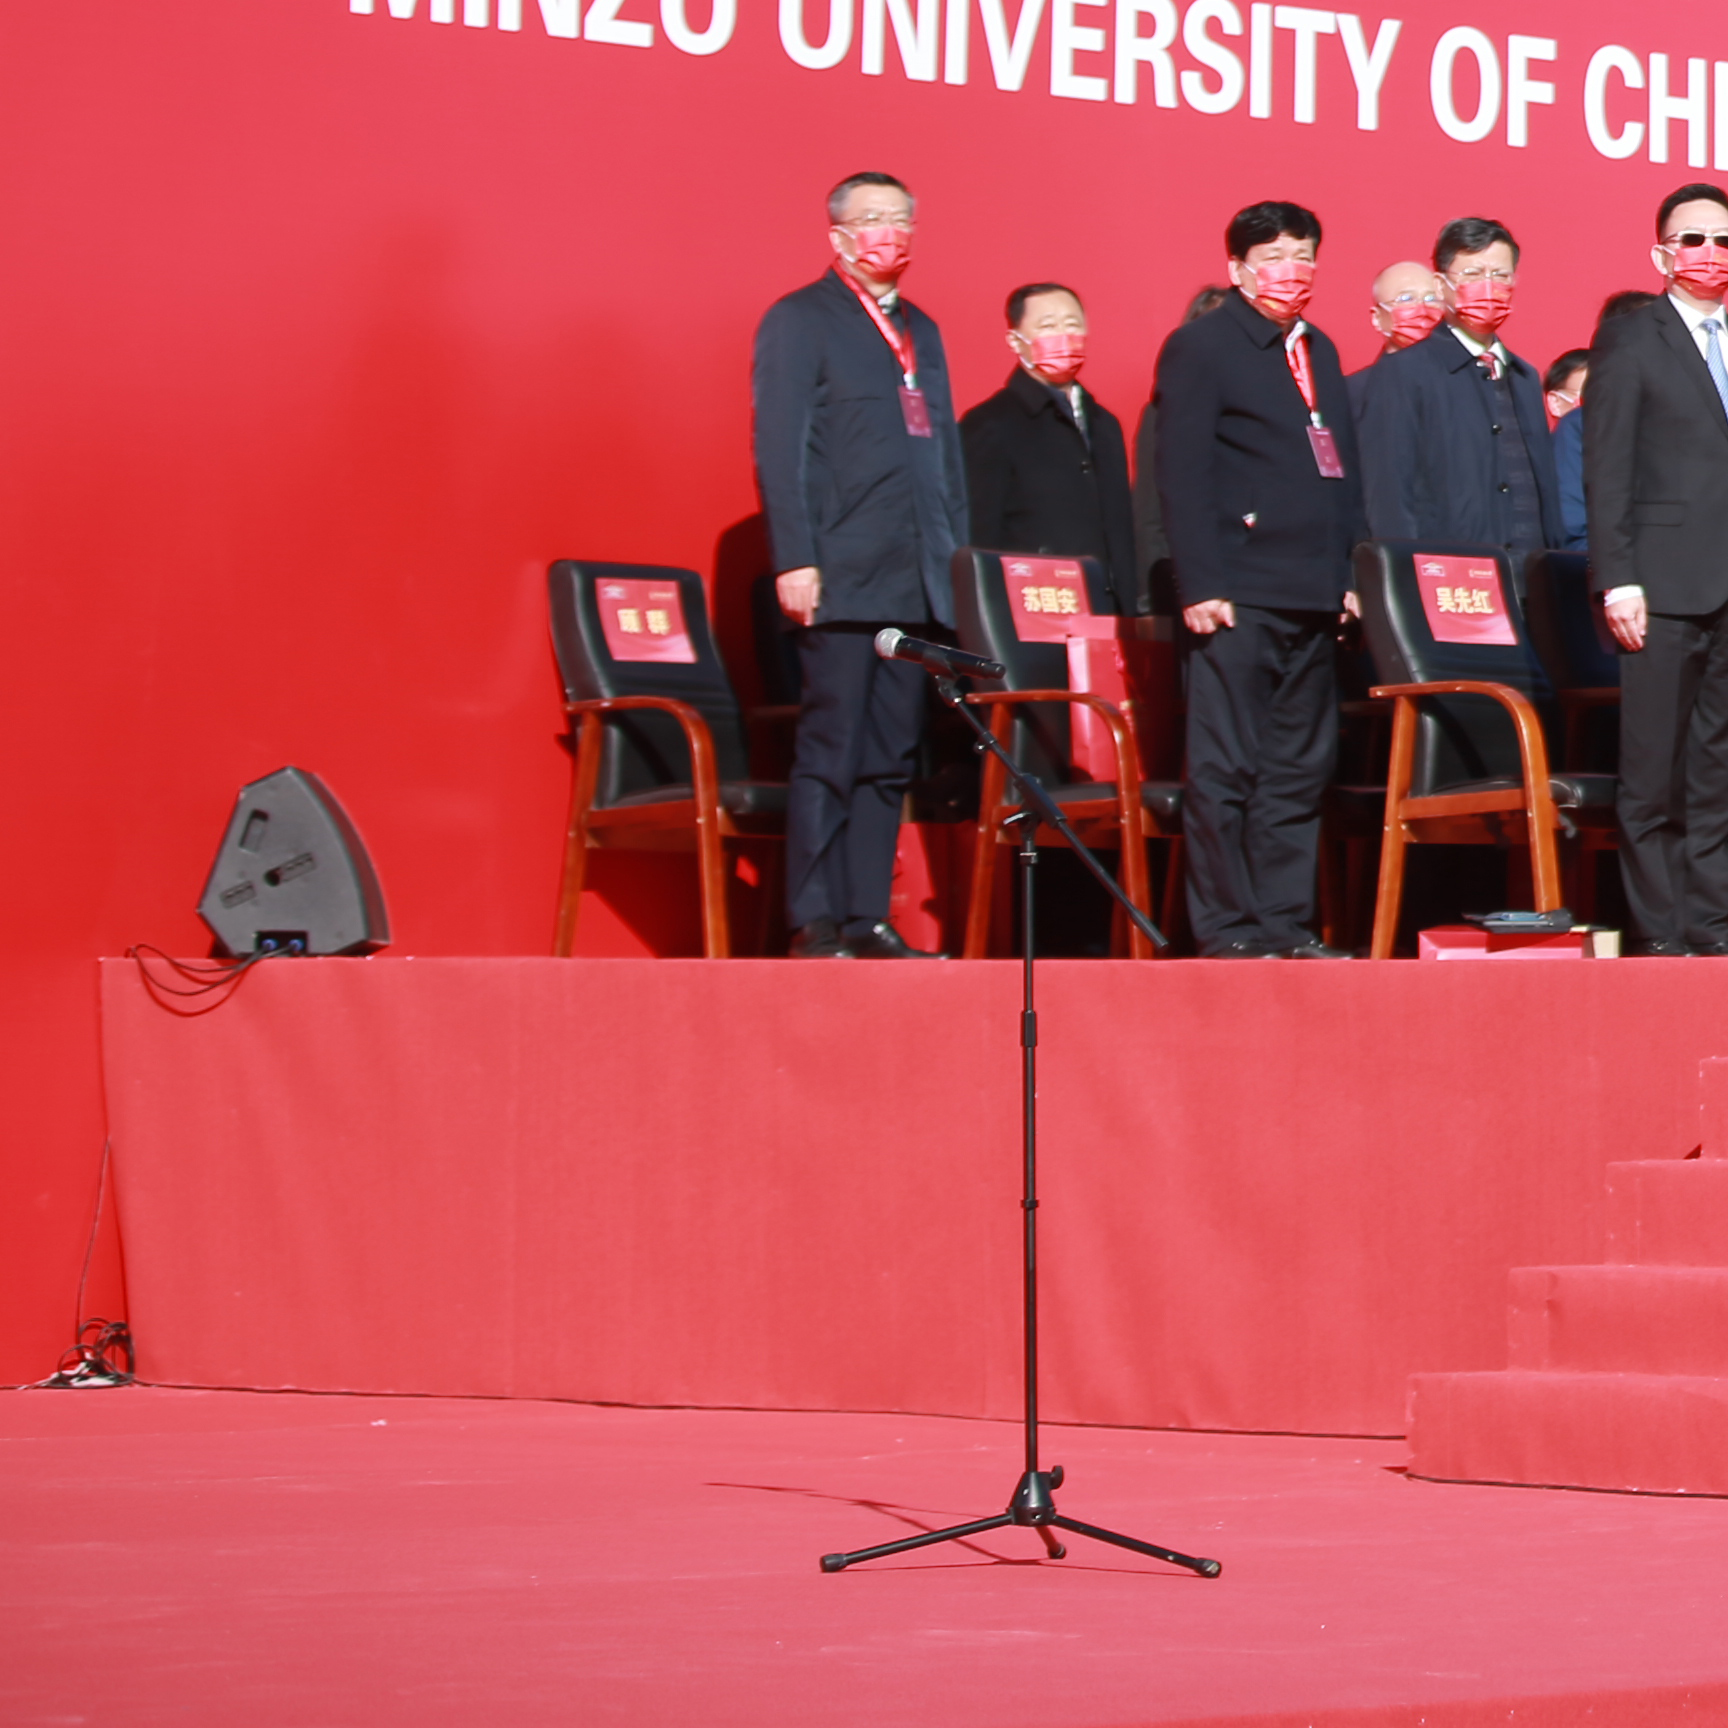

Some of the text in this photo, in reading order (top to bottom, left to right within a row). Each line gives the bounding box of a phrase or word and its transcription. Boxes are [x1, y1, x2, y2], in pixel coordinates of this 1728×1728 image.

[1429, 24, 1559, 149] OF
[1435, 586, 1494, 614] 吴先红
